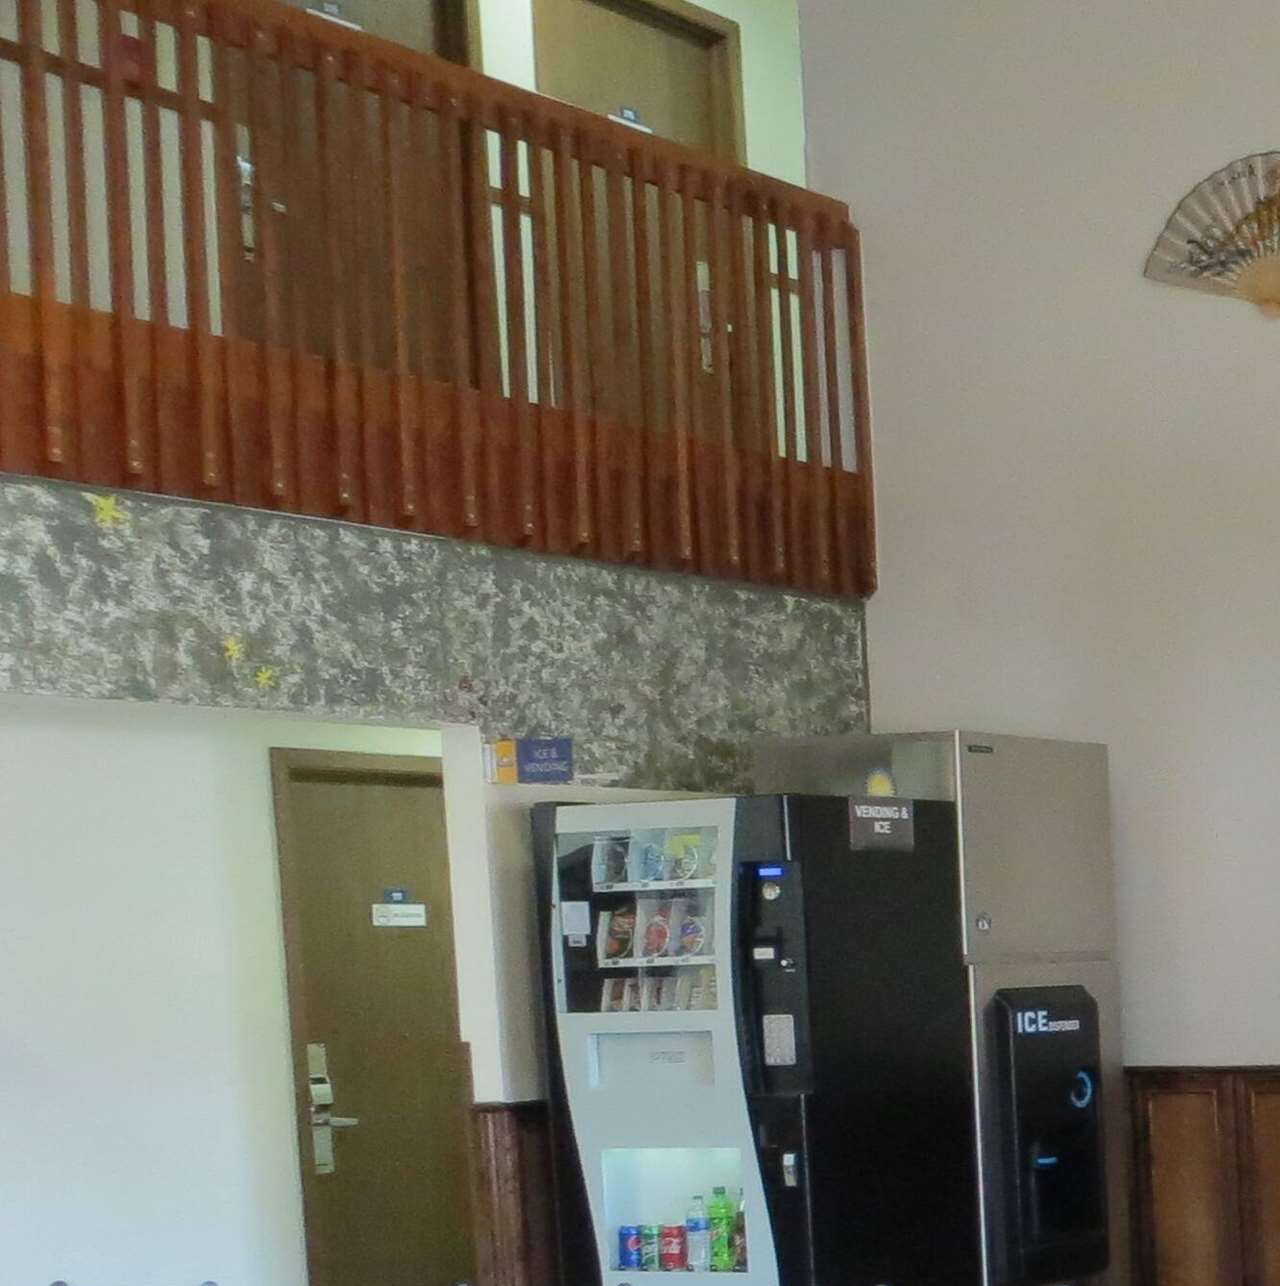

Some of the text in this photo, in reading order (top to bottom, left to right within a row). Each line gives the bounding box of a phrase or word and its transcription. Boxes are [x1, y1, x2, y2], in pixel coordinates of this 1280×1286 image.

[854, 805, 910, 819] VENDING &
[874, 821, 892, 834] ICE
[1017, 1010, 1049, 1034] ICE
